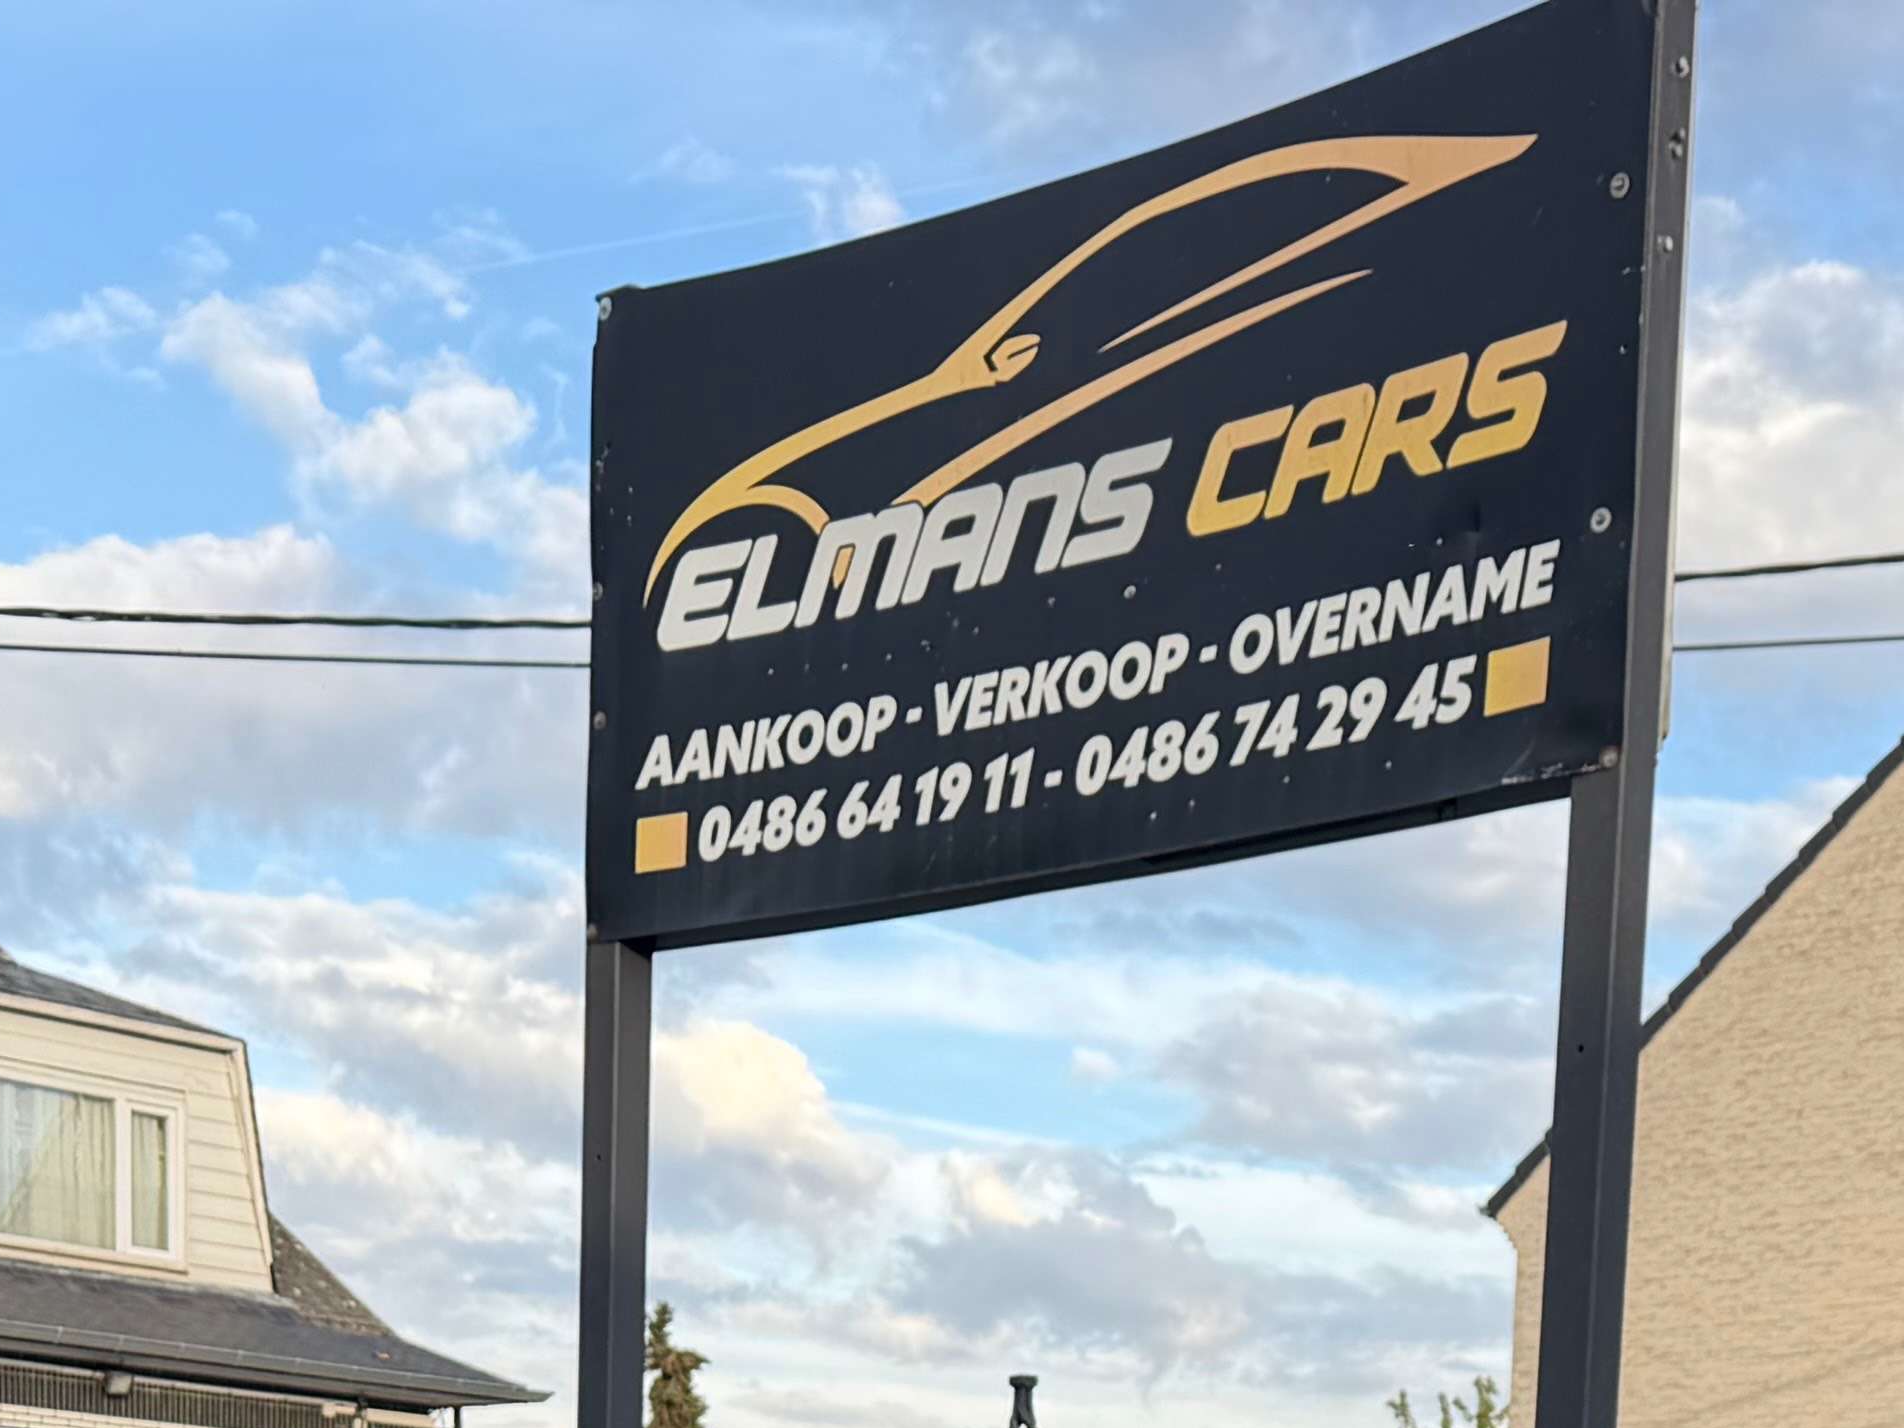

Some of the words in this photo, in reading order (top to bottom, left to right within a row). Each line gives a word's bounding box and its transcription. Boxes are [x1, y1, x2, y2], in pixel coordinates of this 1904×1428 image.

[656, 437, 1172, 652] ELMANS
[1186, 319, 1568, 537] CARS
[635, 695, 895, 790] AANKOOP
[933, 633, 1190, 737] VERKOOP
[1229, 539, 1561, 675] OVERNAME
[698, 788, 827, 863] 0486
[837, 774, 902, 840] 64
[914, 762, 972, 826] 19
[984, 748, 1034, 814] 11
[1075, 711, 1220, 796] 0486
[1230, 694, 1299, 767] 74
[1305, 677, 1387, 751] 29
[1394, 655, 1477, 730] 45
